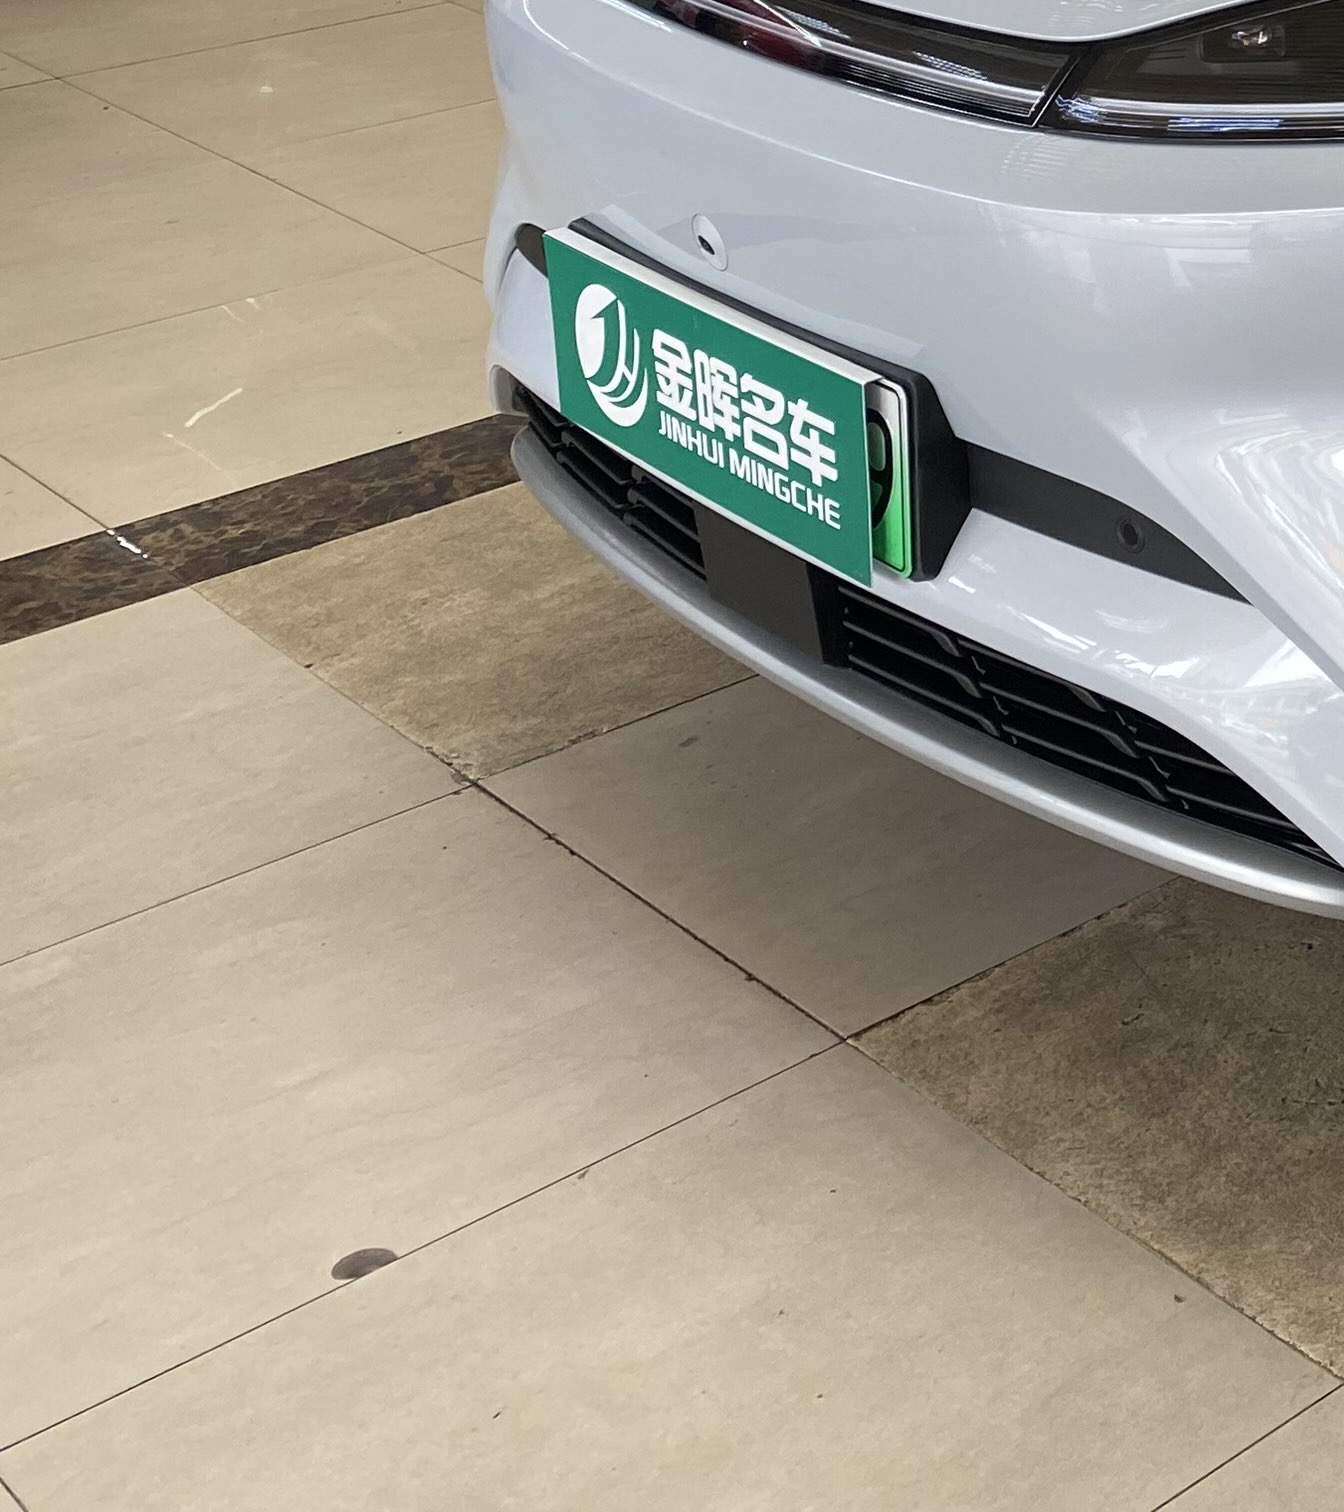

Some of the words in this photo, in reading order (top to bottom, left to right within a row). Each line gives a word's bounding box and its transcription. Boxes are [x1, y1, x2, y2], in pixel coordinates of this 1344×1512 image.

[651, 328, 838, 488] 金晖名车
[658, 410, 725, 470] JINHUI
[728, 451, 842, 530] MINGCHE
